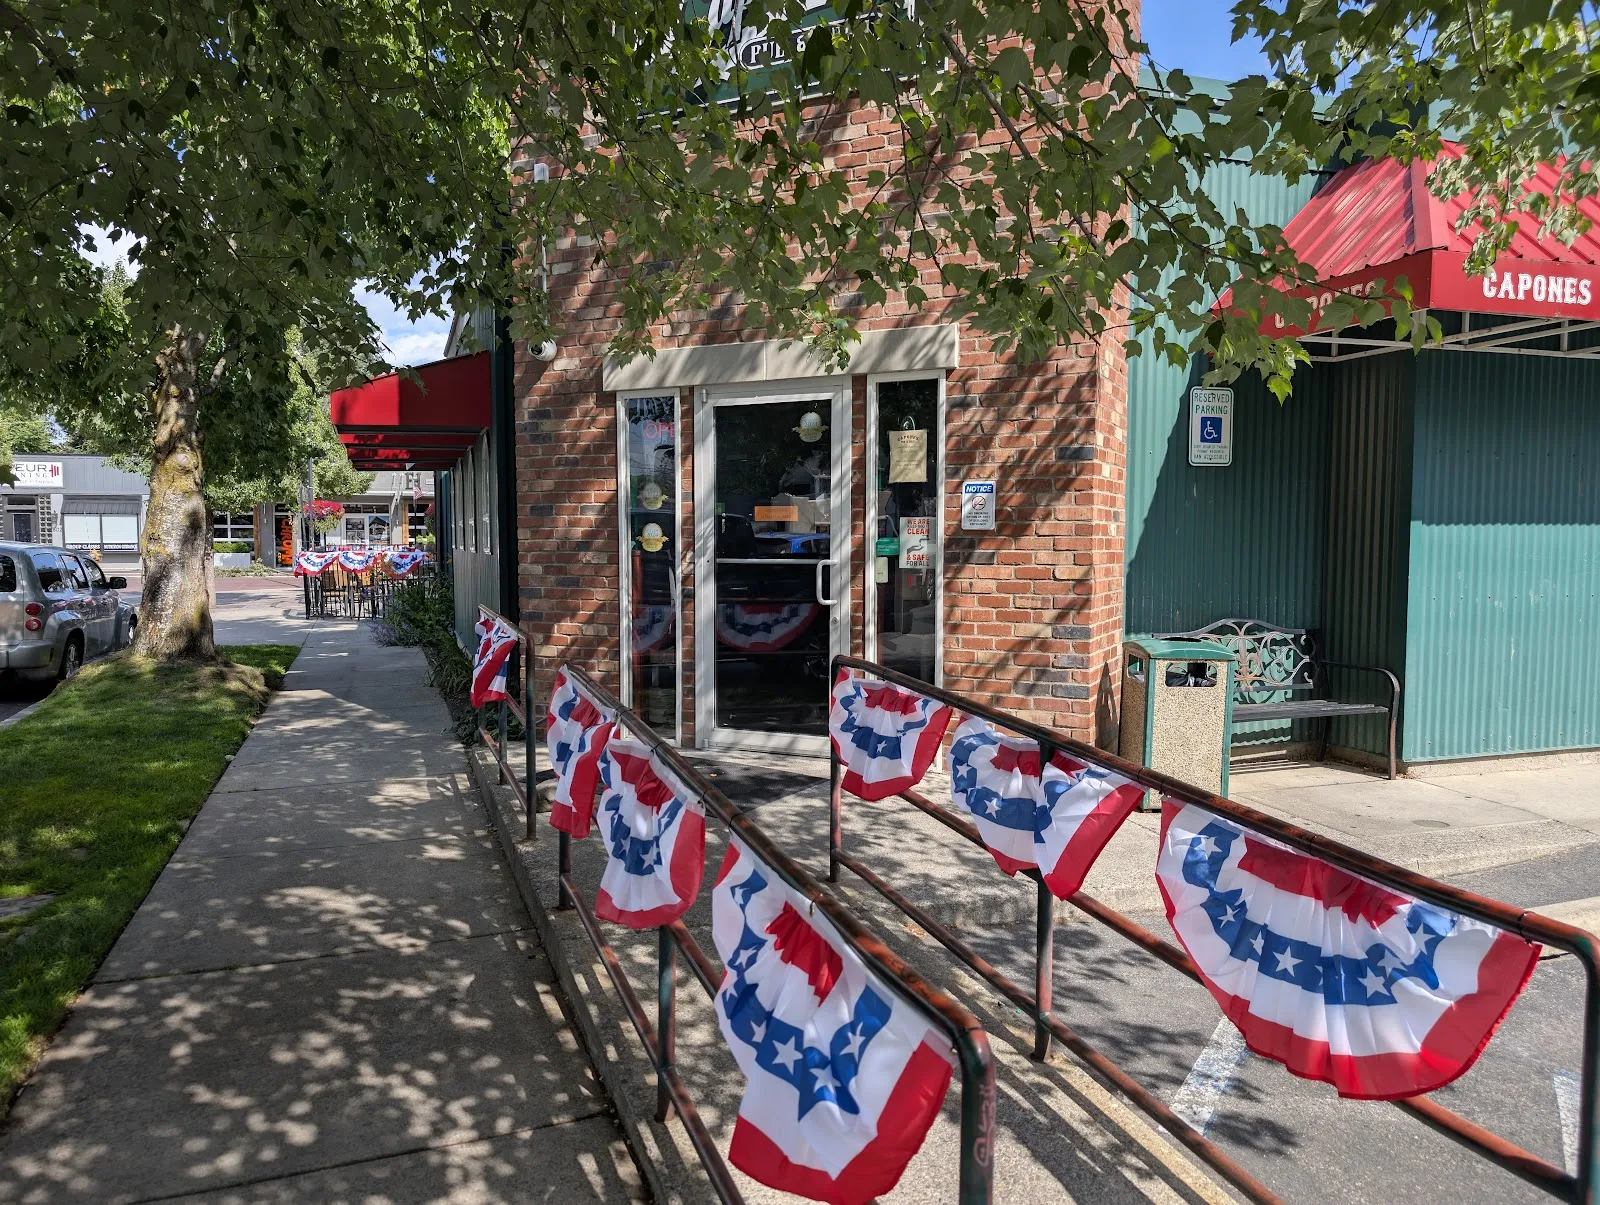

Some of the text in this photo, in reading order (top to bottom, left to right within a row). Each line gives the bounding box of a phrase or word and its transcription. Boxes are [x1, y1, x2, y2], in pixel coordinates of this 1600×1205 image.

[1482, 270, 1592, 306] CAPONES
[1194, 392, 1230, 403] RESERVED
[1195, 404, 1228, 415] PARKING
[644, 421, 676, 439] OPE
[14, 463, 48, 472] EUR
[966, 485, 992, 493] NOTICE
